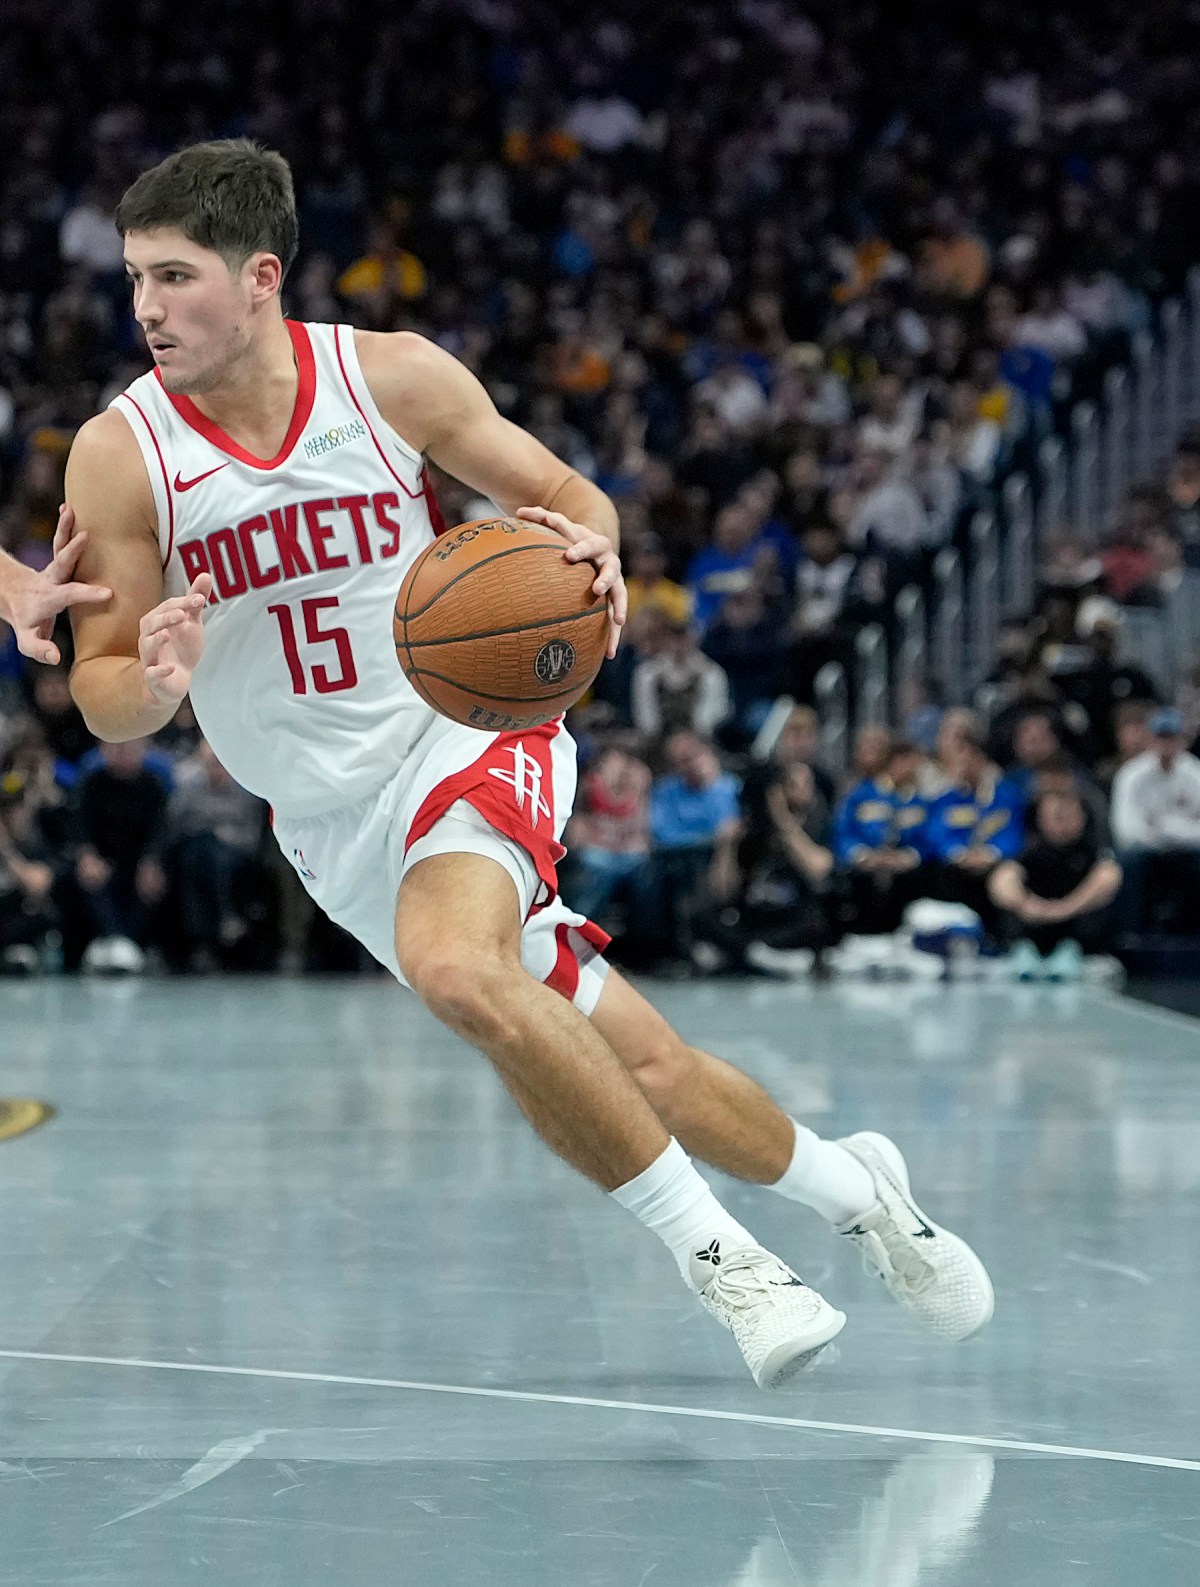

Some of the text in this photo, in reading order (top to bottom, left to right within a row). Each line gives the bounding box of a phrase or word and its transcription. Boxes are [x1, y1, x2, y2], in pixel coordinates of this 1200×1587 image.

[304, 419, 364, 450] MEMORIAL
[305, 425, 365, 459] HERMANN
[176, 492, 401, 607] ROCKETS
[267, 596, 358, 695] 15
